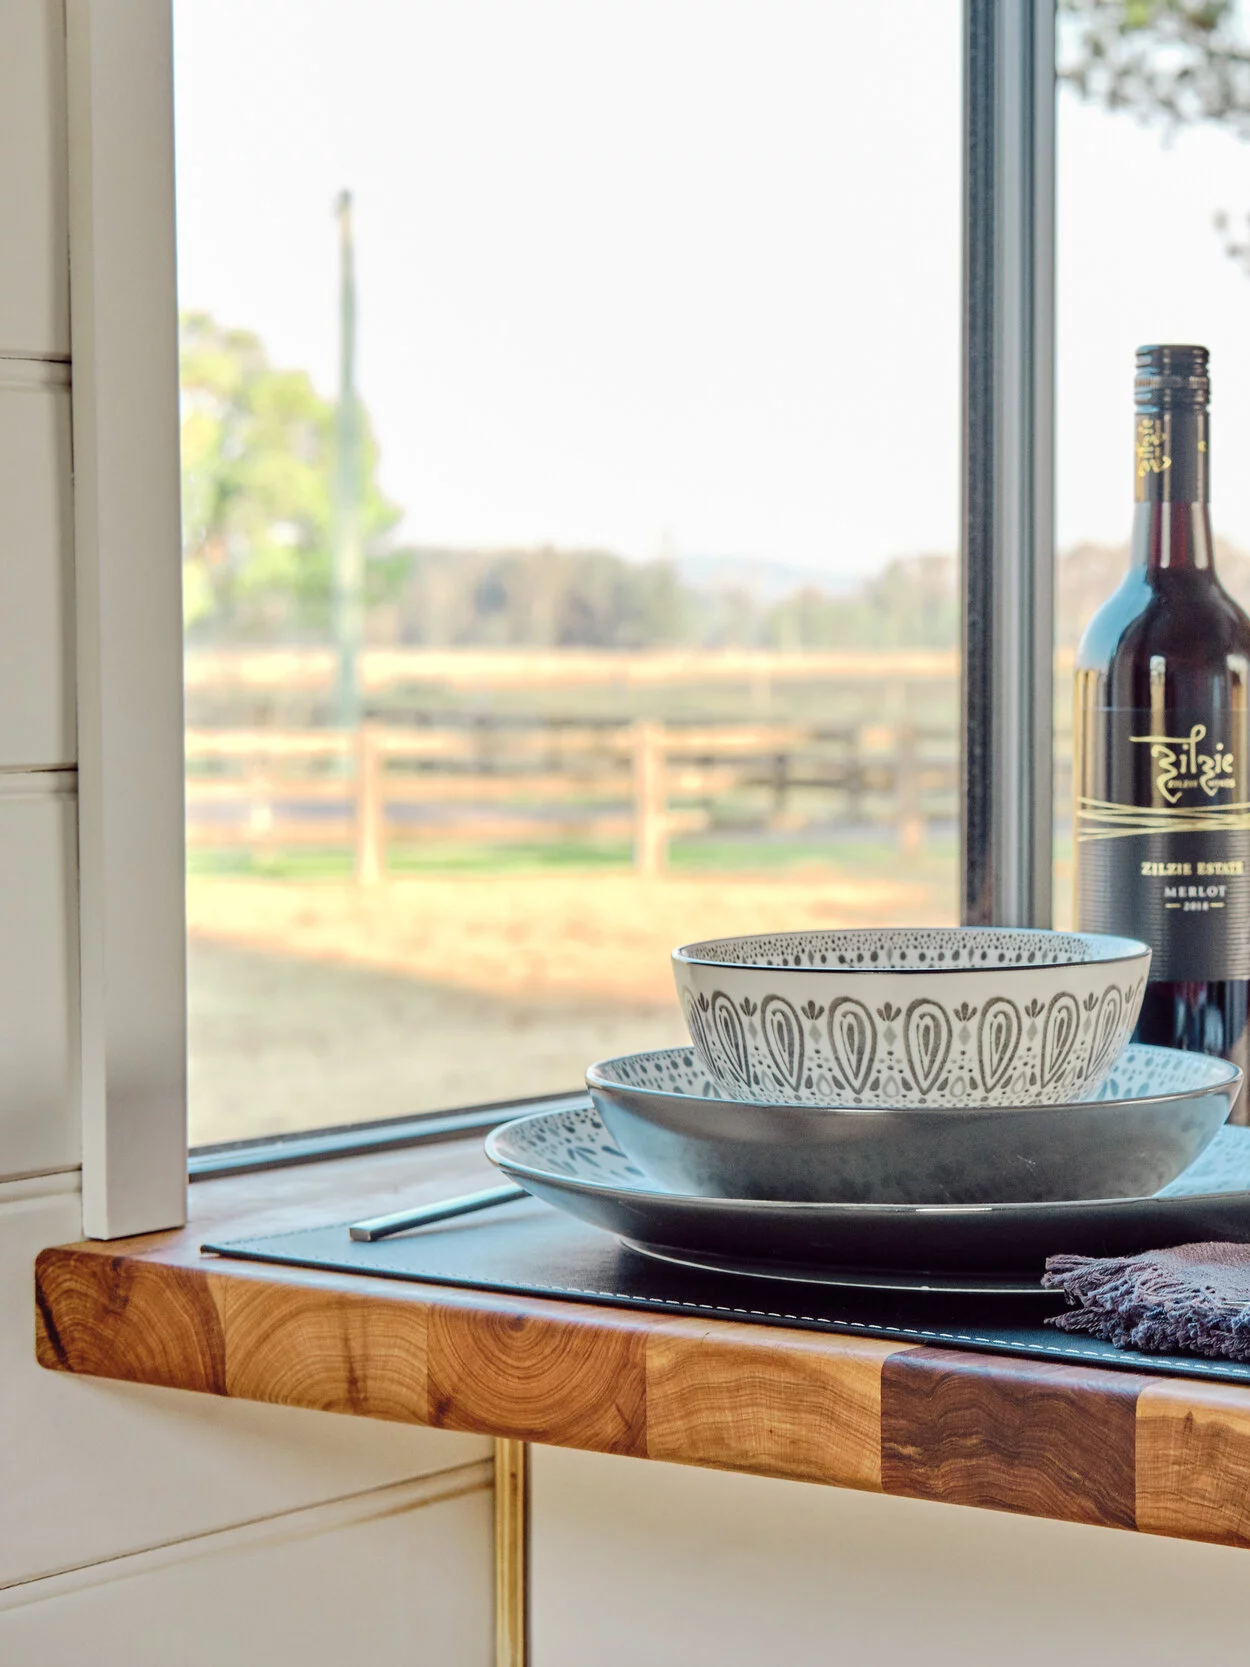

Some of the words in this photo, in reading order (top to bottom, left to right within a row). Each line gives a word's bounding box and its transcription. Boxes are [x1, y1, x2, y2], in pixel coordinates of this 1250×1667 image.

[1141, 862, 1192, 876] ZILZIE
[1197, 861, 1244, 876] ESTATE
[1164, 885, 1226, 898] MERLOT
